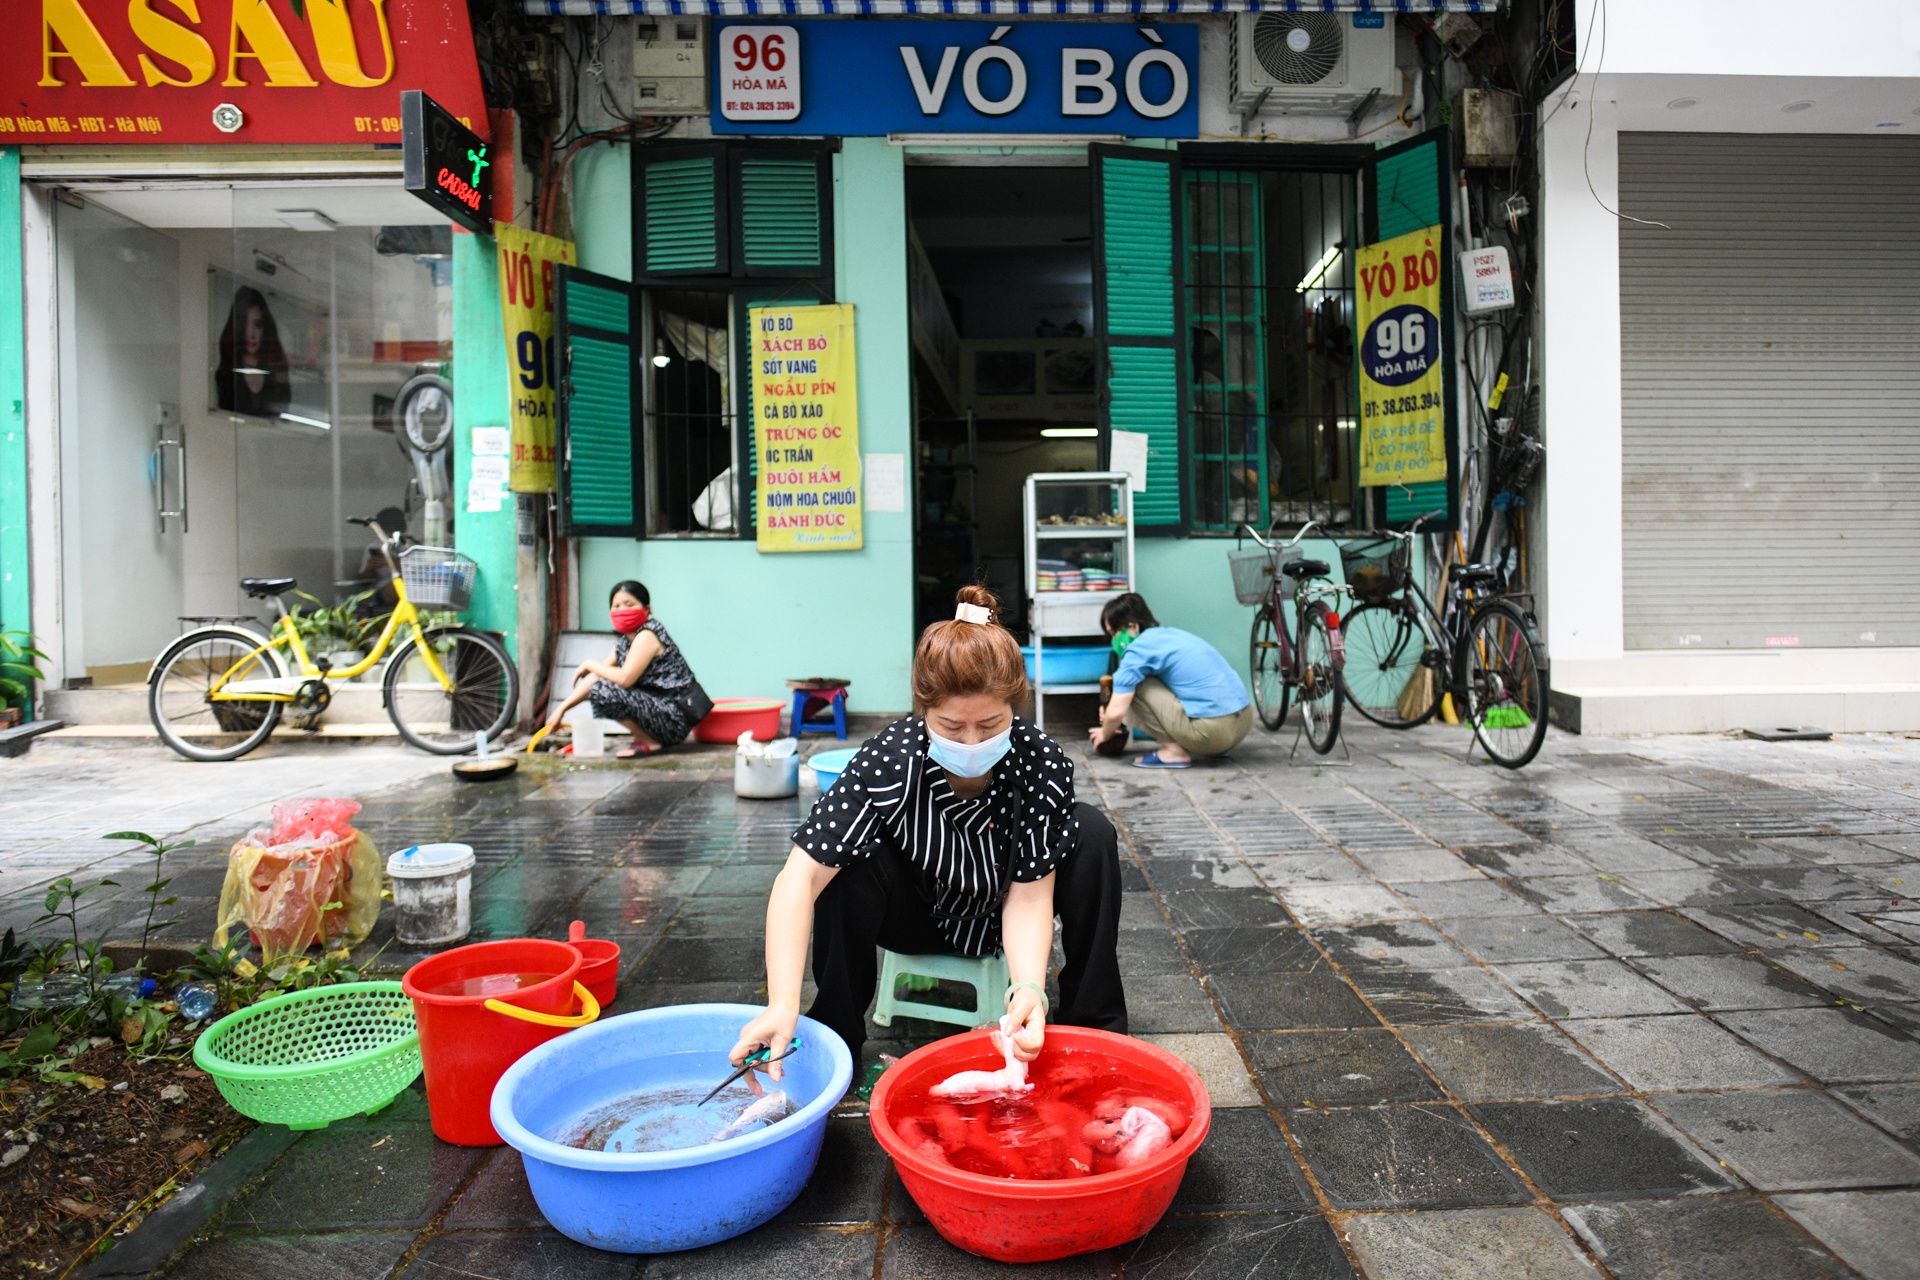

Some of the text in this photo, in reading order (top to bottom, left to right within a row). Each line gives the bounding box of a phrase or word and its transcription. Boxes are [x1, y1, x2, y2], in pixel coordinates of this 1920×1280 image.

[732, 34, 786, 72] 96
[899, 25, 1189, 119] VÓ BÒ
[732, 75, 788, 90] HÒA MÃ
[17, 116, 46, 133] Hòa
[47, 116, 71, 132] Mã
[79, 117, 106, 132] HBT
[116, 116, 136, 132] Hà
[137, 116, 163, 134] Nội
[503, 242, 535, 310] VÓ
[1360, 238, 1439, 302] VÓ BÒ
[761, 313, 793, 332] VÓ BÒ
[762, 333, 828, 352] XÁCH BÒ
[1376, 312, 1426, 360] 96
[763, 355, 817, 375] SỐT VANG
[1375, 354, 1427, 378] HÒA MÃ
[811, 378, 836, 396] PÍN
[518, 394, 548, 419] HÒA
[783, 401, 797, 419] BÒ
[1365, 391, 1441, 418] ĐT: 38.263.394
[765, 424, 818, 441] TRỨNG
[766, 468, 803, 485] ĐUÔI
[767, 485, 856, 510] NỘM HOA CHUỐI
[767, 510, 845, 529] BÁNH ĐÚC
